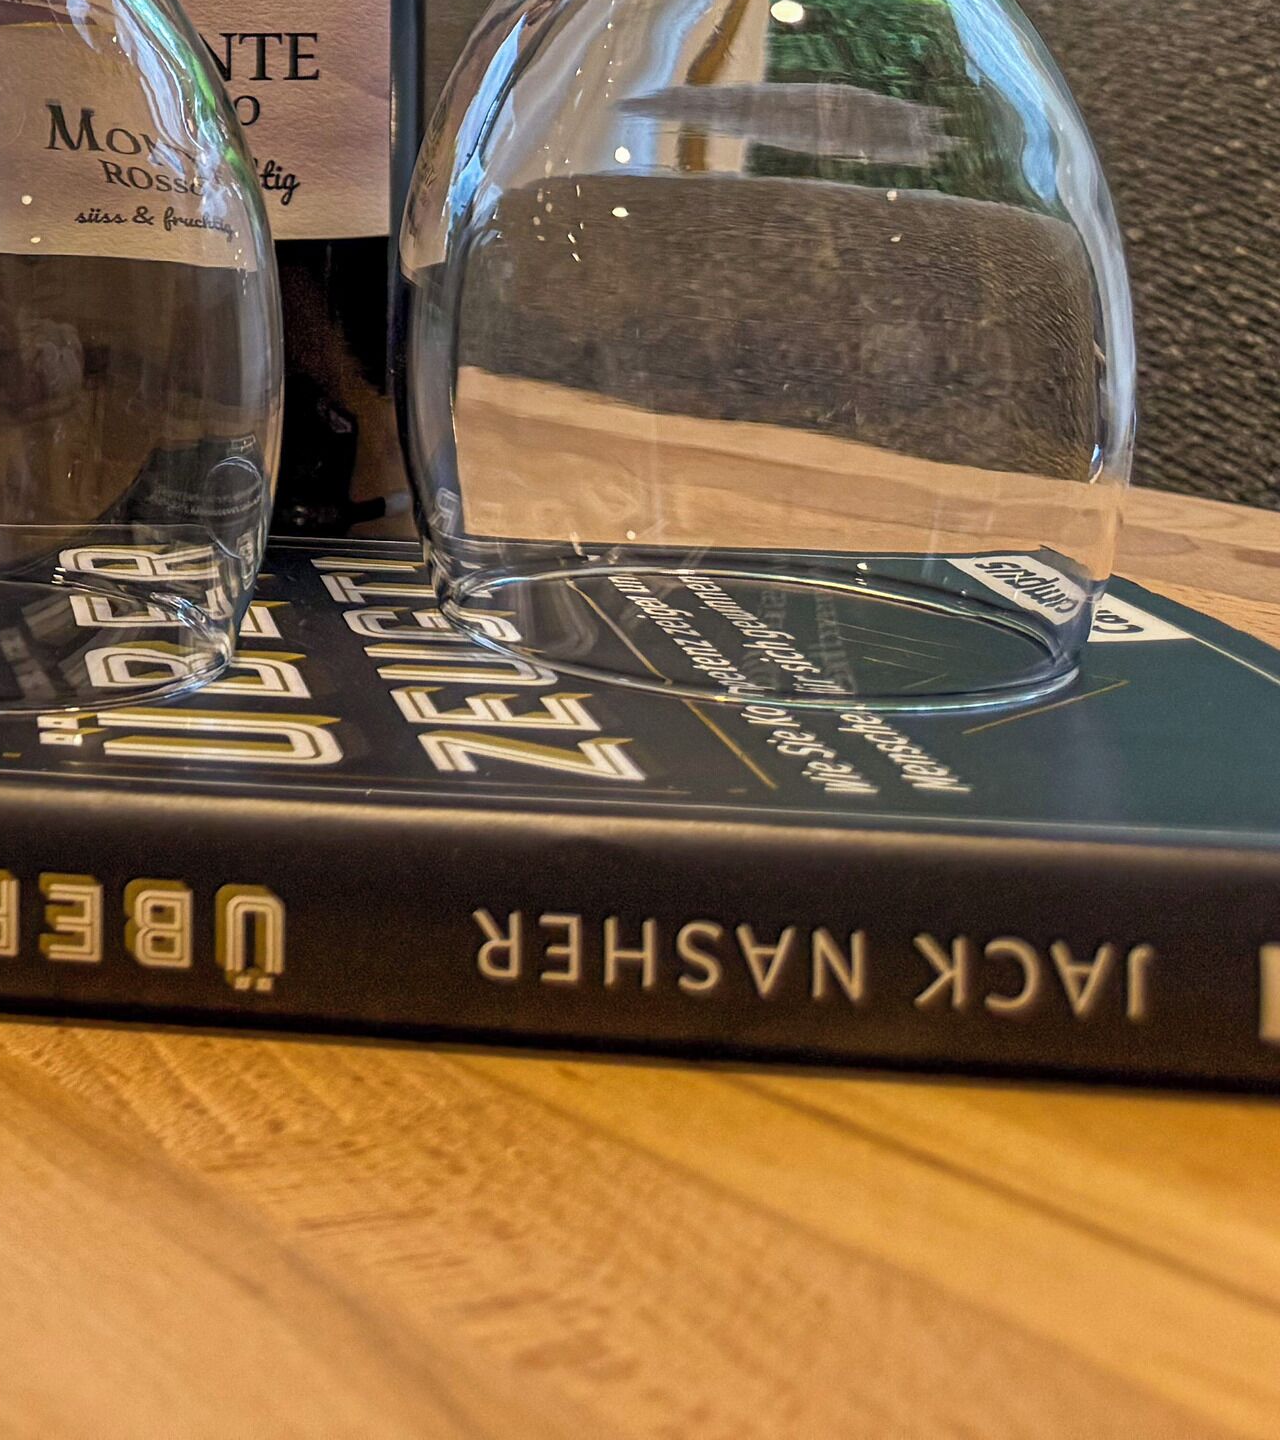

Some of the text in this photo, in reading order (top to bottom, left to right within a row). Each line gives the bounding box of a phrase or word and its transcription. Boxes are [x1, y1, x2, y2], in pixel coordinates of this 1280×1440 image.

[198, 32, 321, 82] NTE
[74, 206, 128, 224] süss
[131, 206, 155, 225] &
[607, 574, 652, 594] un
[742, 640, 822, 674] sich
[766, 729, 838, 760] Sie
[838, 705, 972, 793] Mensche
[801, 760, 881, 795] Wie
[471, 909, 1156, 1021] JACK NASHER
